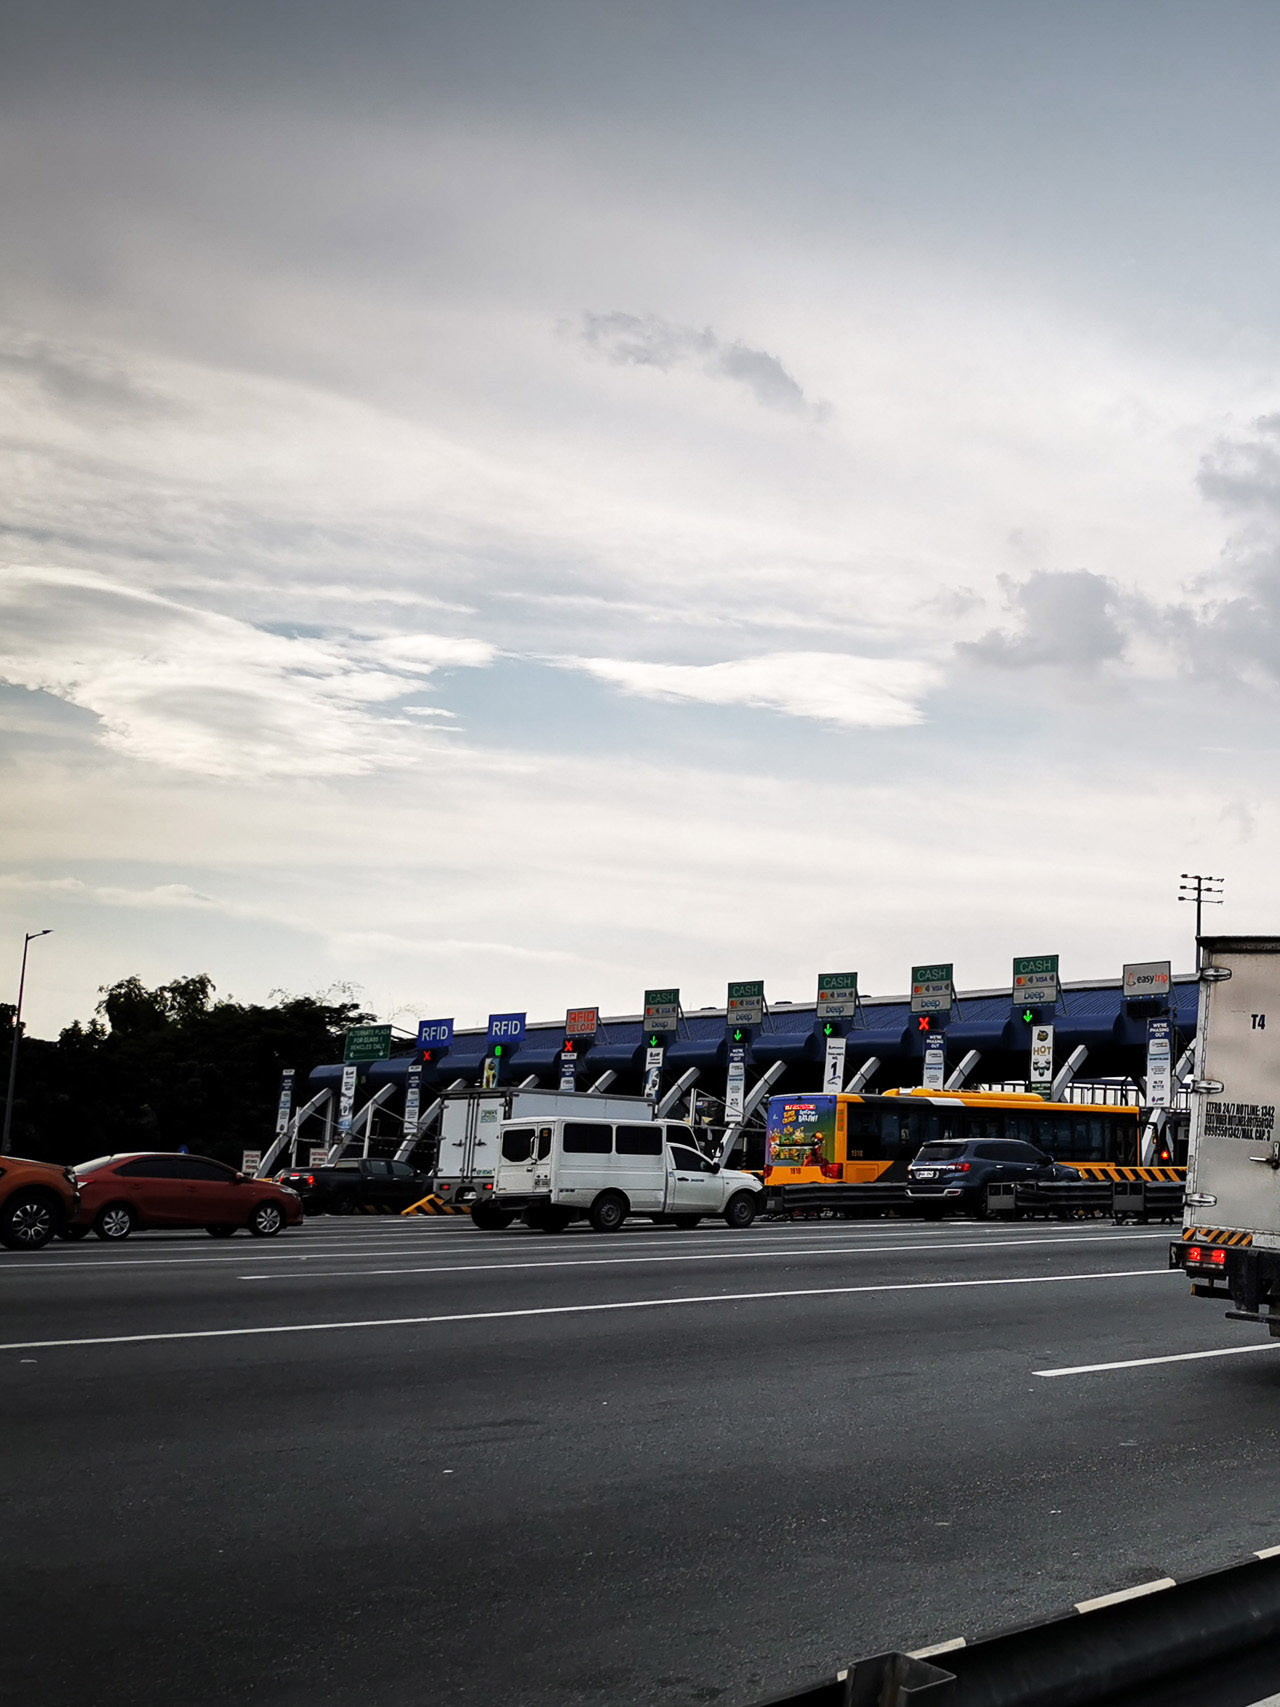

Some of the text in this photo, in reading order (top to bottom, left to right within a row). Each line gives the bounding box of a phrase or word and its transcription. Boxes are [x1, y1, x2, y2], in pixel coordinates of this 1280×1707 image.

[1020, 960, 1051, 972] CASH
[918, 968, 946, 981] CASH
[1137, 973, 1168, 984] easytrip
[824, 977, 851, 988] CASH
[732, 985, 758, 996] CASH
[1024, 991, 1045, 1001] beep
[649, 993, 674, 1004] CASH
[921, 1000, 940, 1009] beep
[826, 1005, 844, 1016] beep
[568, 1010, 596, 1023] RFID
[1250, 1014, 1266, 1030] T4
[492, 1020, 520, 1036] RFID
[568, 1023, 596, 1032] RELOAD
[421, 1026, 448, 1042] RFID
[1033, 1046, 1052, 1056] HOT
[1222, 1102, 1236, 1114] 24/7
[1261, 1105, 1276, 1118] 1342
